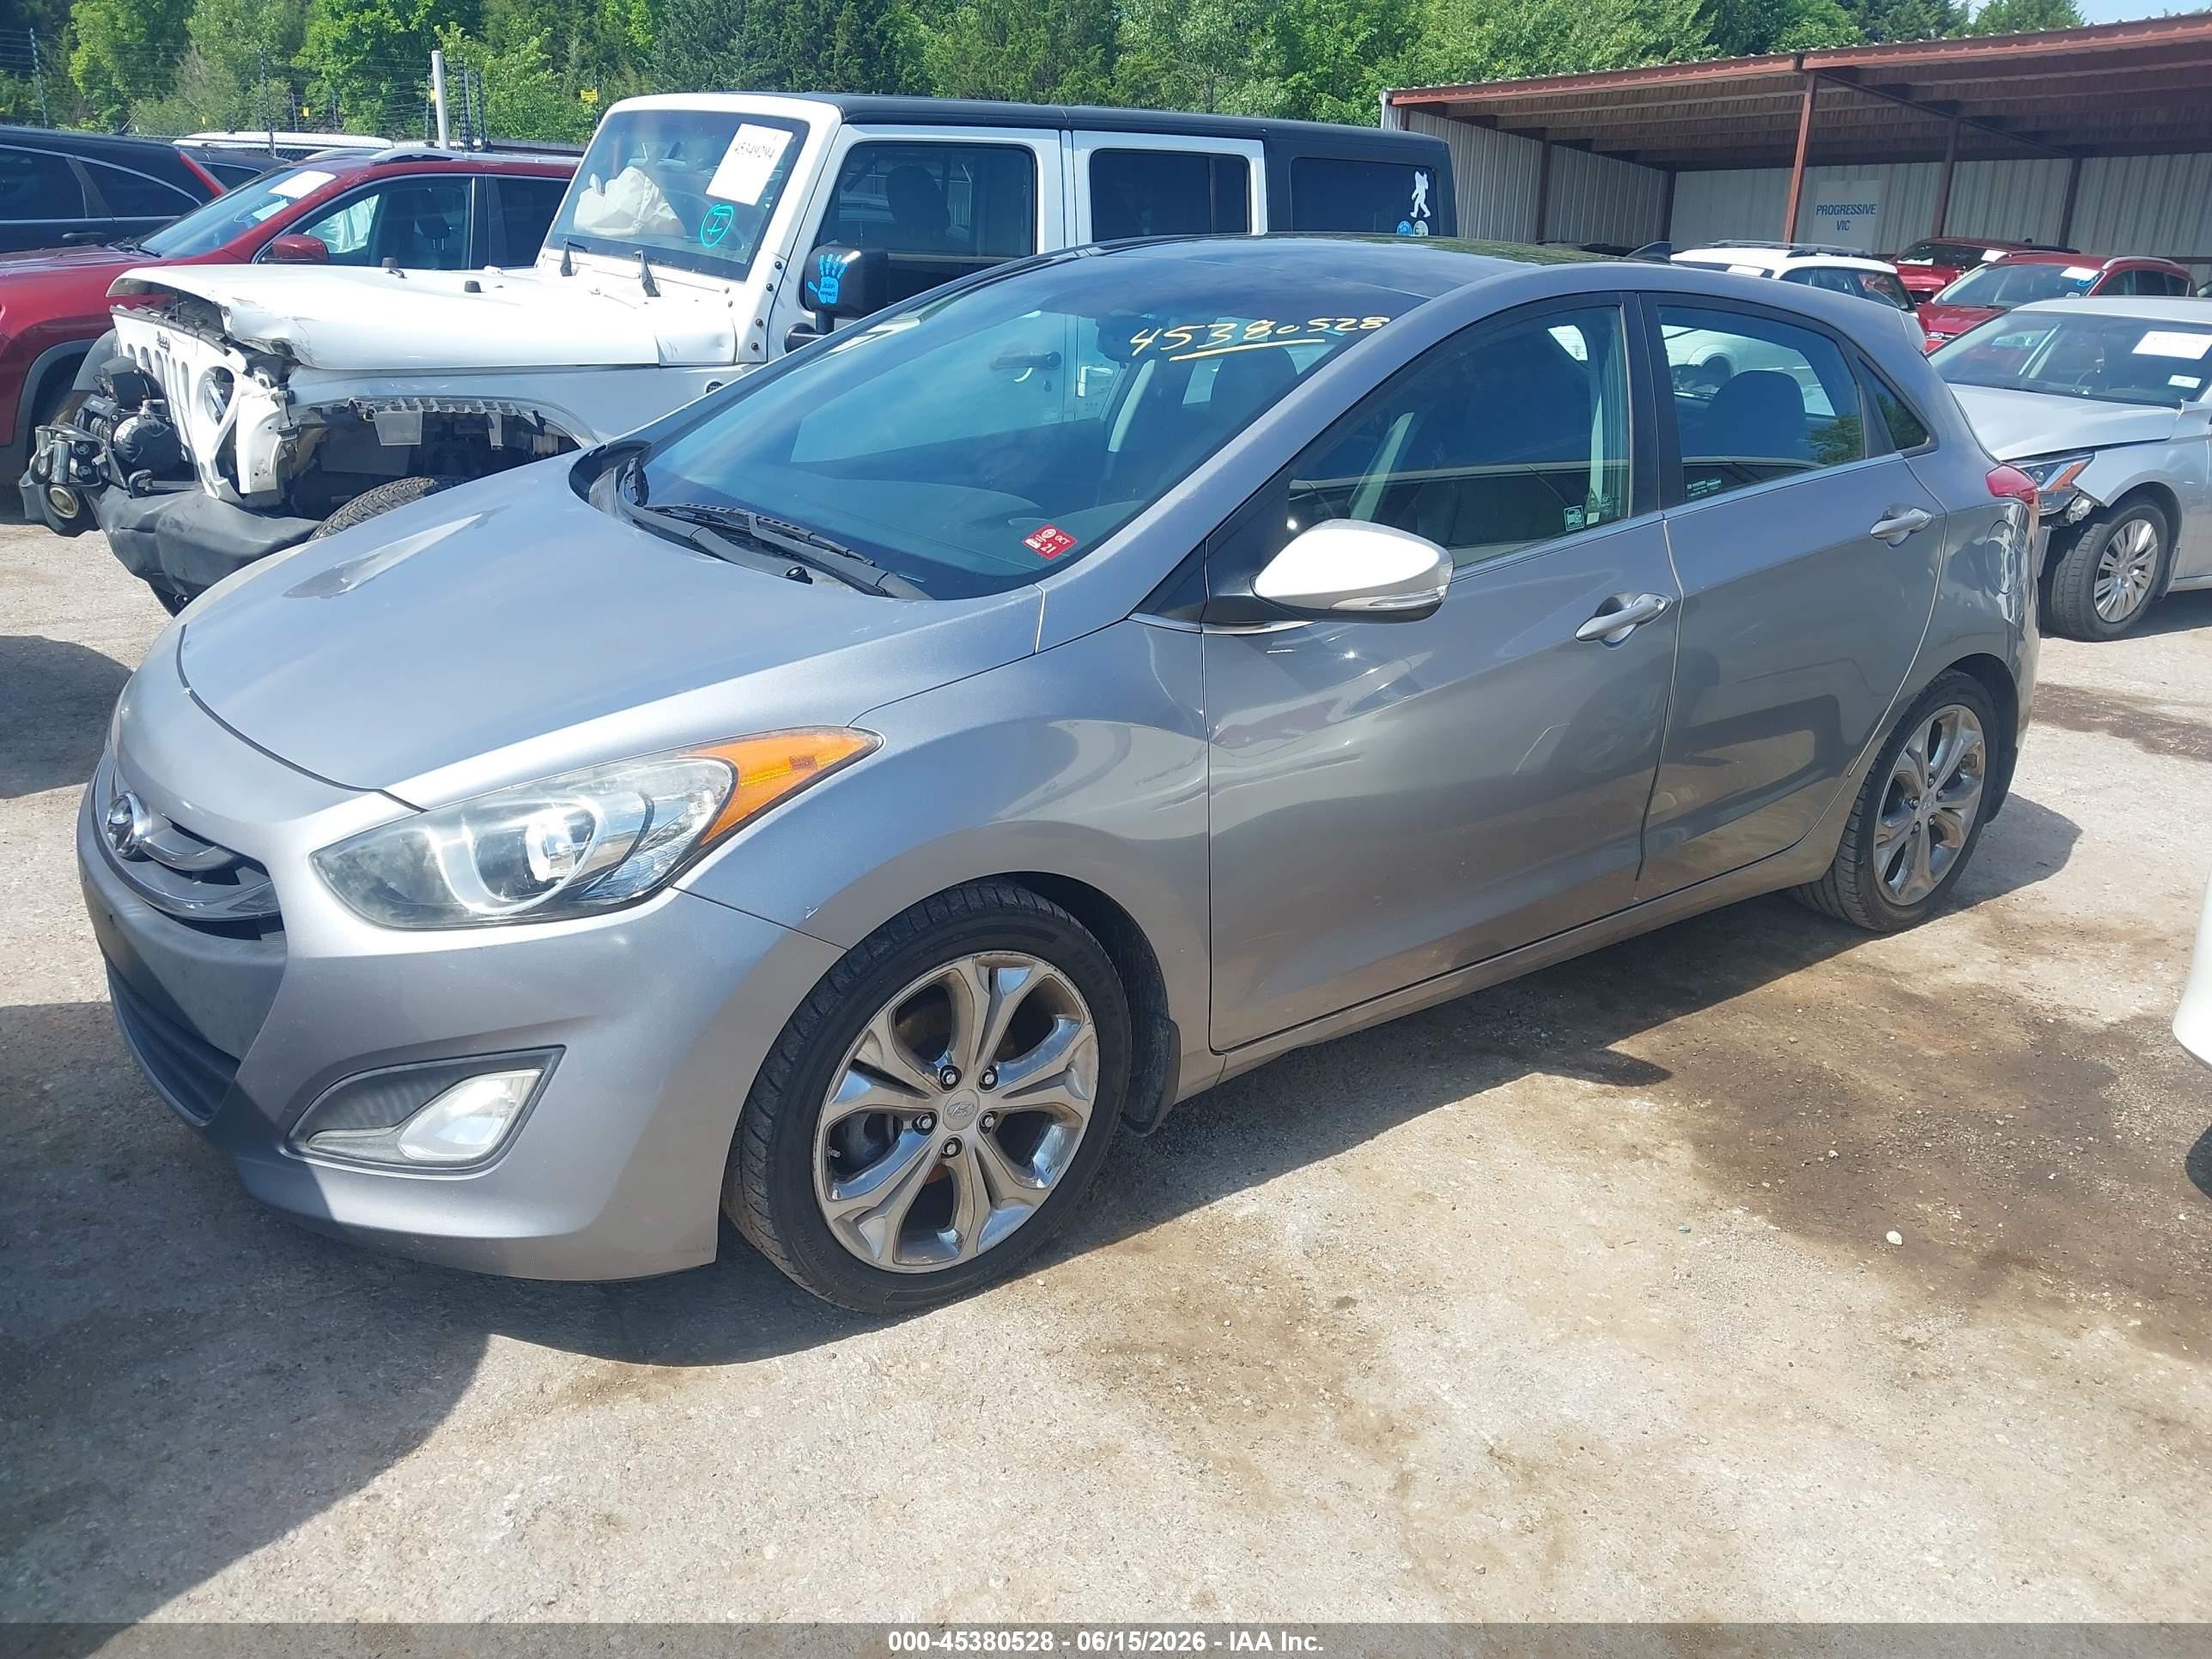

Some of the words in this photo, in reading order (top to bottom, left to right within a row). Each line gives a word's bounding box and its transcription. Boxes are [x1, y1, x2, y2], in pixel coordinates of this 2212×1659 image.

[1816, 204, 1876, 216] PROGRESSIVE
[1836, 220, 1850, 231] VIC
[1129, 317, 1390, 356] 45380528
[1054, 535, 1071, 544] OCT
[1040, 543, 1057, 554] 21
